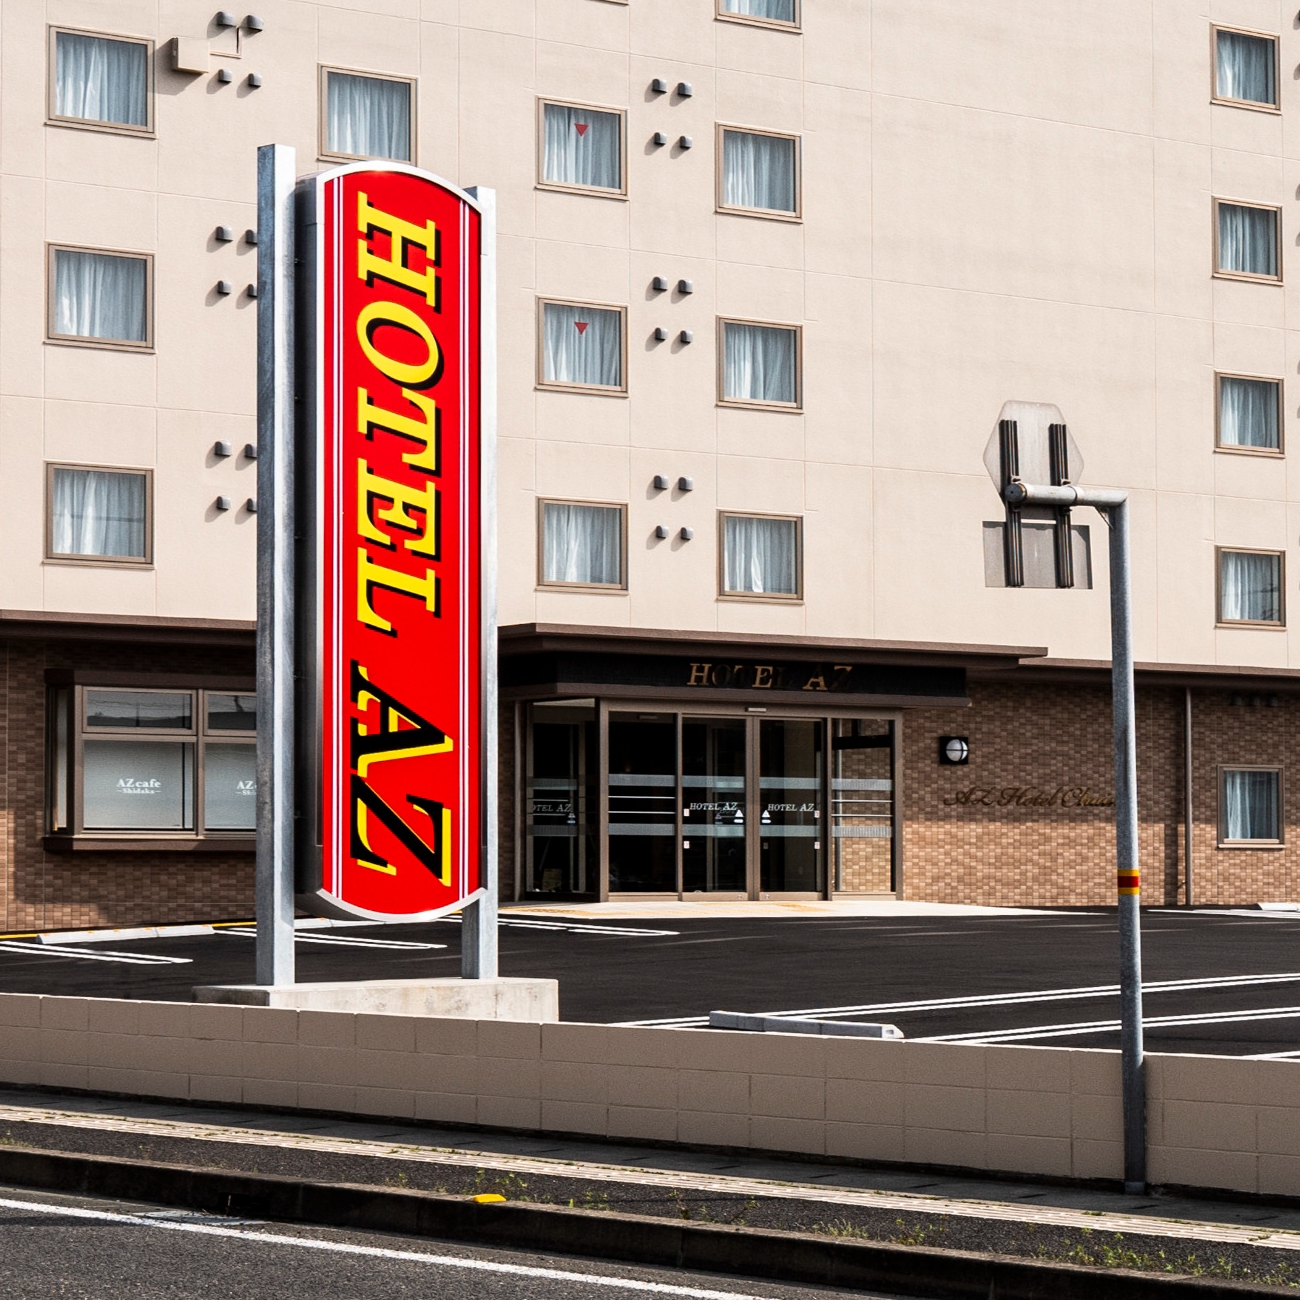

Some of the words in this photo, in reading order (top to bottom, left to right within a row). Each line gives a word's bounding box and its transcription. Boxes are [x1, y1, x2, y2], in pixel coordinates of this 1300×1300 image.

[356, 190, 444, 638] HOTEL
[686, 663, 793, 689] HOTEL
[802, 664, 853, 692] AZ
[350, 659, 454, 887] AZ
[689, 802, 720, 810] HOTEL
[723, 802, 738, 810] AZ
[767, 803, 797, 811] HOTEL
[800, 803, 815, 811] AZ
